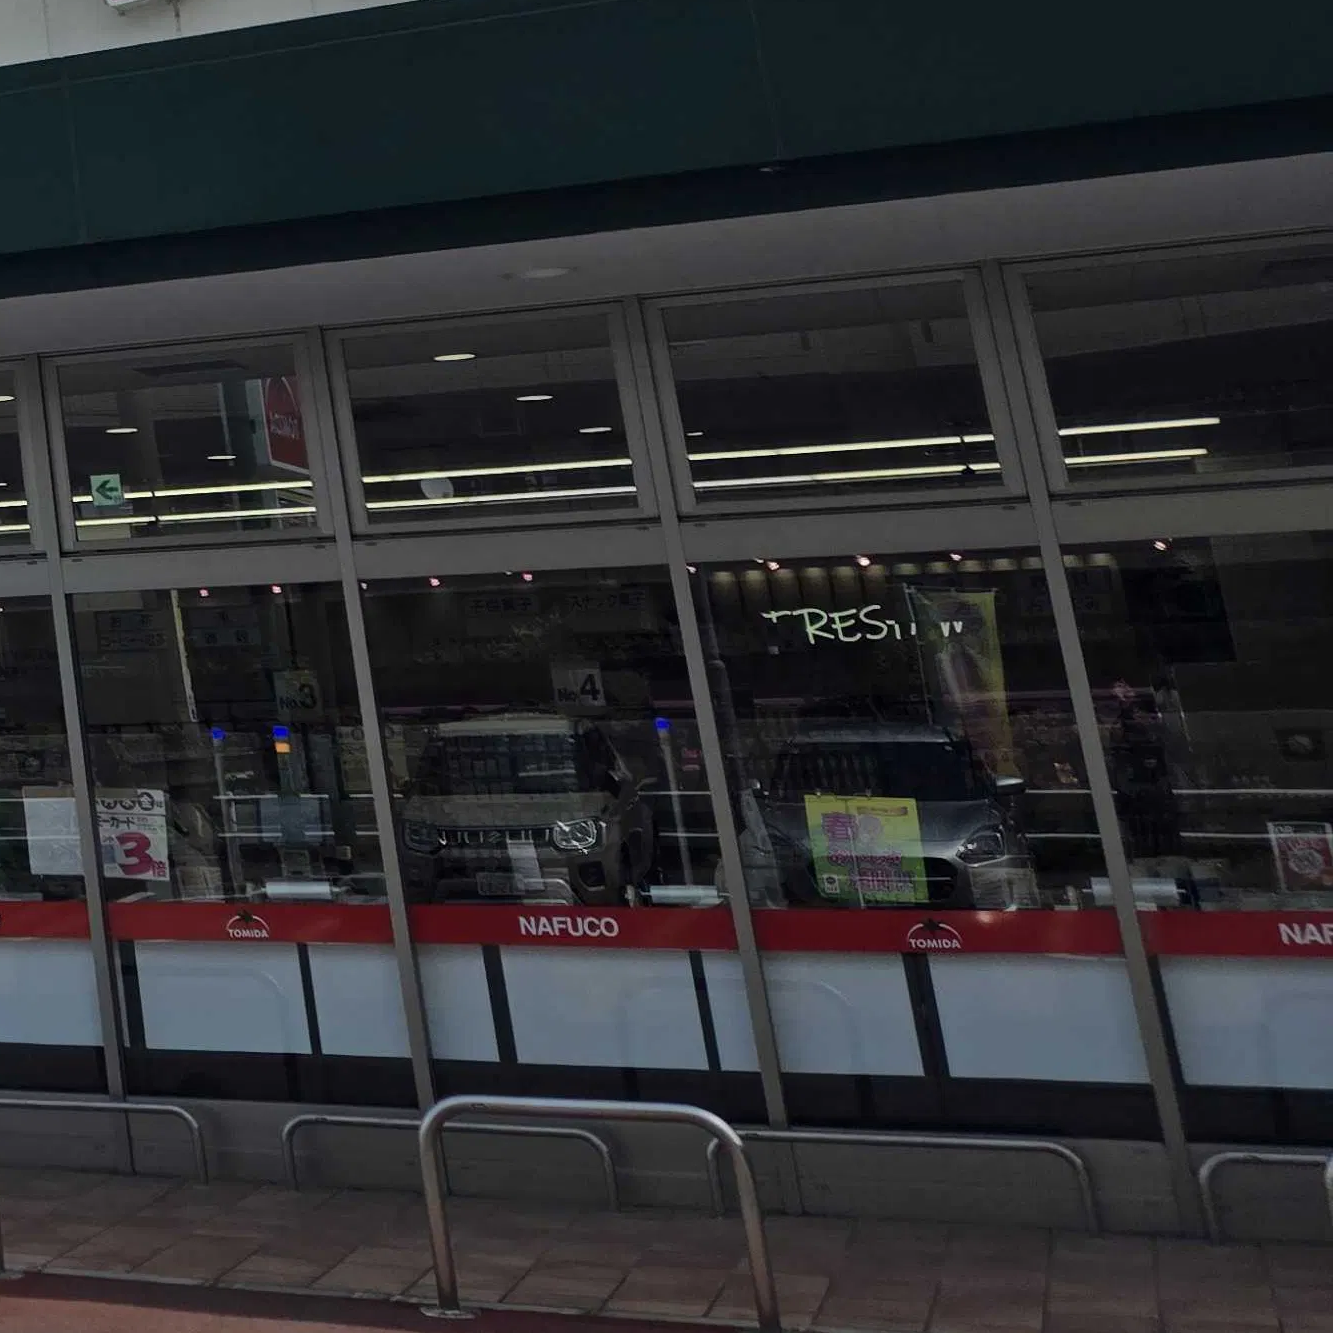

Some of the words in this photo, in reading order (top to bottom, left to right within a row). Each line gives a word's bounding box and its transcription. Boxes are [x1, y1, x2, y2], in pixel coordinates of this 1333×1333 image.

[227, 926, 270, 939] TOMIDA
[519, 915, 619, 938] NAFUCO
[908, 936, 962, 950] TOMIDA
